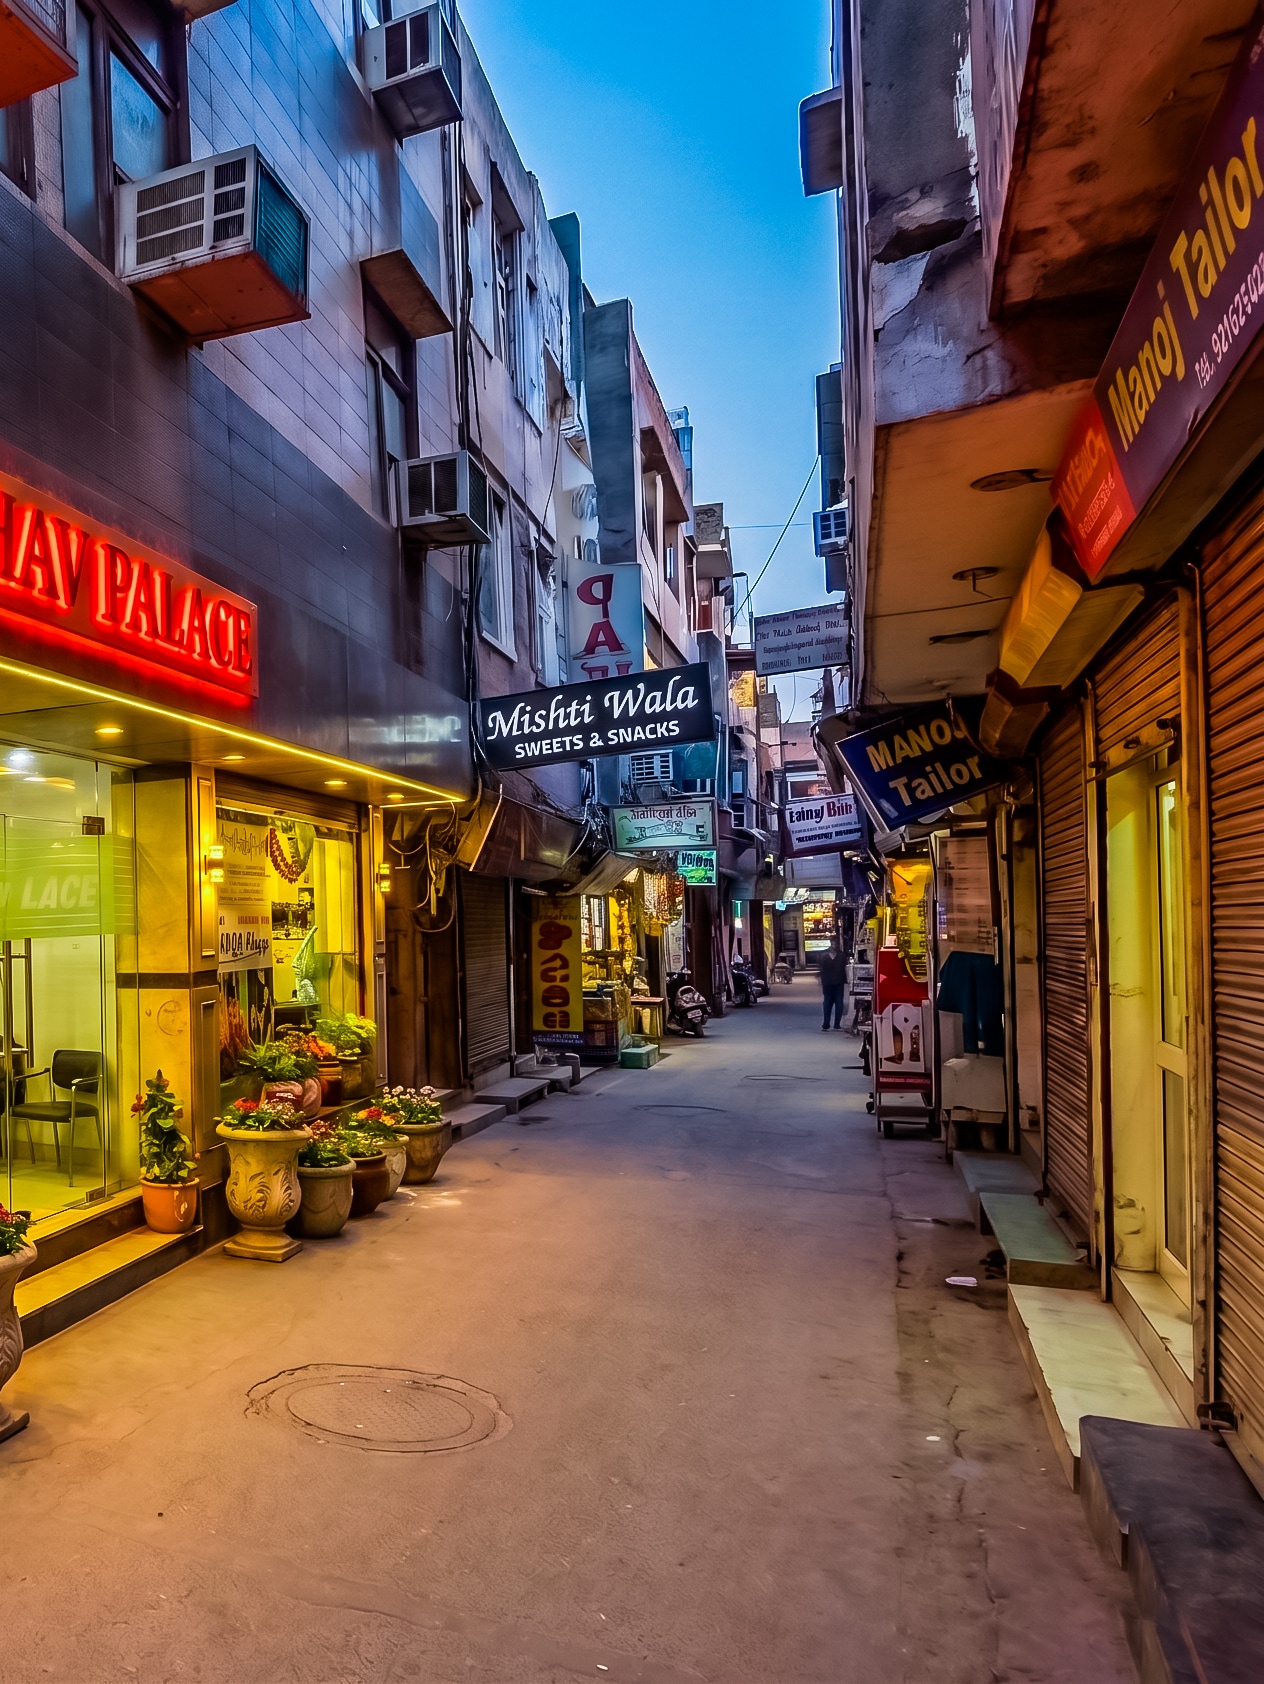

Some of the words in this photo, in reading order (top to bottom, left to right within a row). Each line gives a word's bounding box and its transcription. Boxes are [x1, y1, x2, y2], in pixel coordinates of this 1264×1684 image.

[1108, 279, 1185, 452] Manoj
[1170, 116, 1264, 320] Tailor
[94, 543, 252, 677] PALACE
[487, 694, 594, 740] Mishti
[604, 675, 698, 719] Wala
[515, 735, 583, 758] SWEETS
[589, 733, 604, 748] &
[608, 720, 679, 744] SNACKS
[889, 755, 982, 806] Tailor
